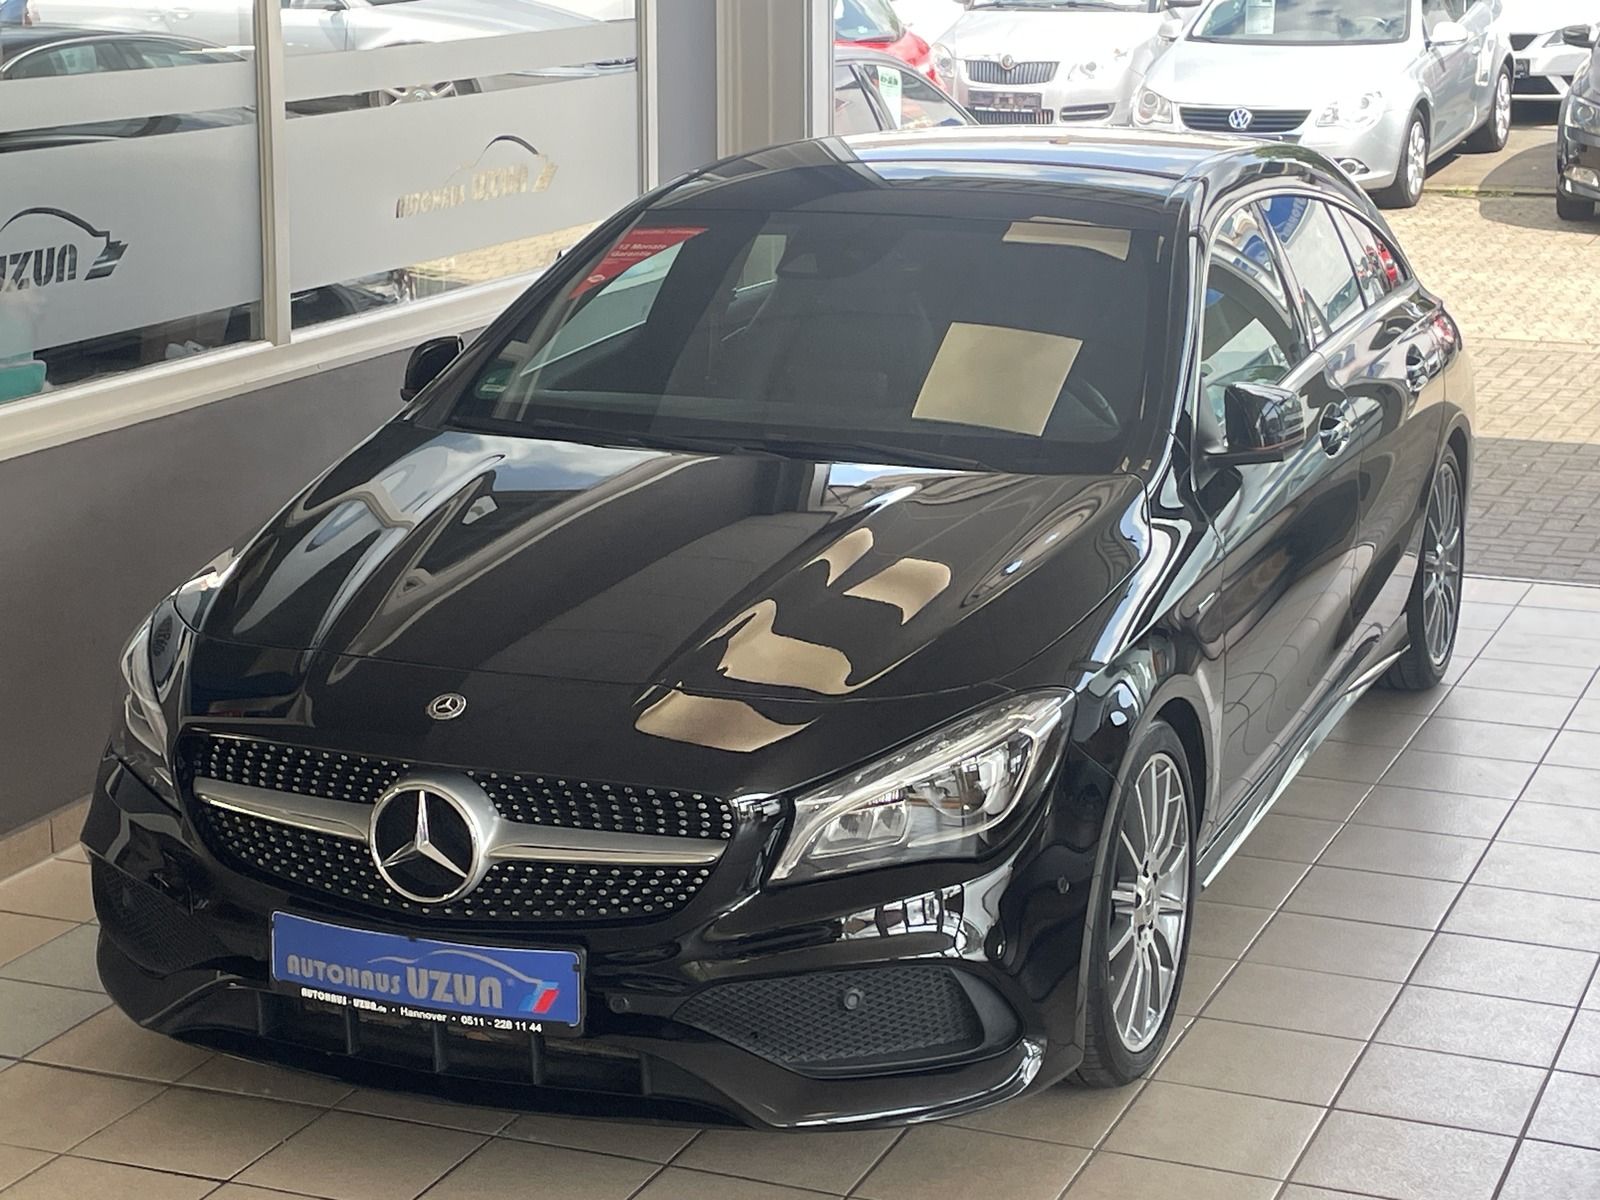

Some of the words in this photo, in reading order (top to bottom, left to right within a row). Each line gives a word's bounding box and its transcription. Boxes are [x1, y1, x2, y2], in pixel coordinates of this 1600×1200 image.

[1229, 109, 1252, 129] VW
[287, 954, 400, 995] AUTOHAUS
[406, 966, 503, 1009] UZUN
[400, 1006, 447, 1022] Hannover
[460, 1015, 485, 1026] 0511
[515, 1021, 526, 1031] 11
[528, 1022, 542, 1033] 44
